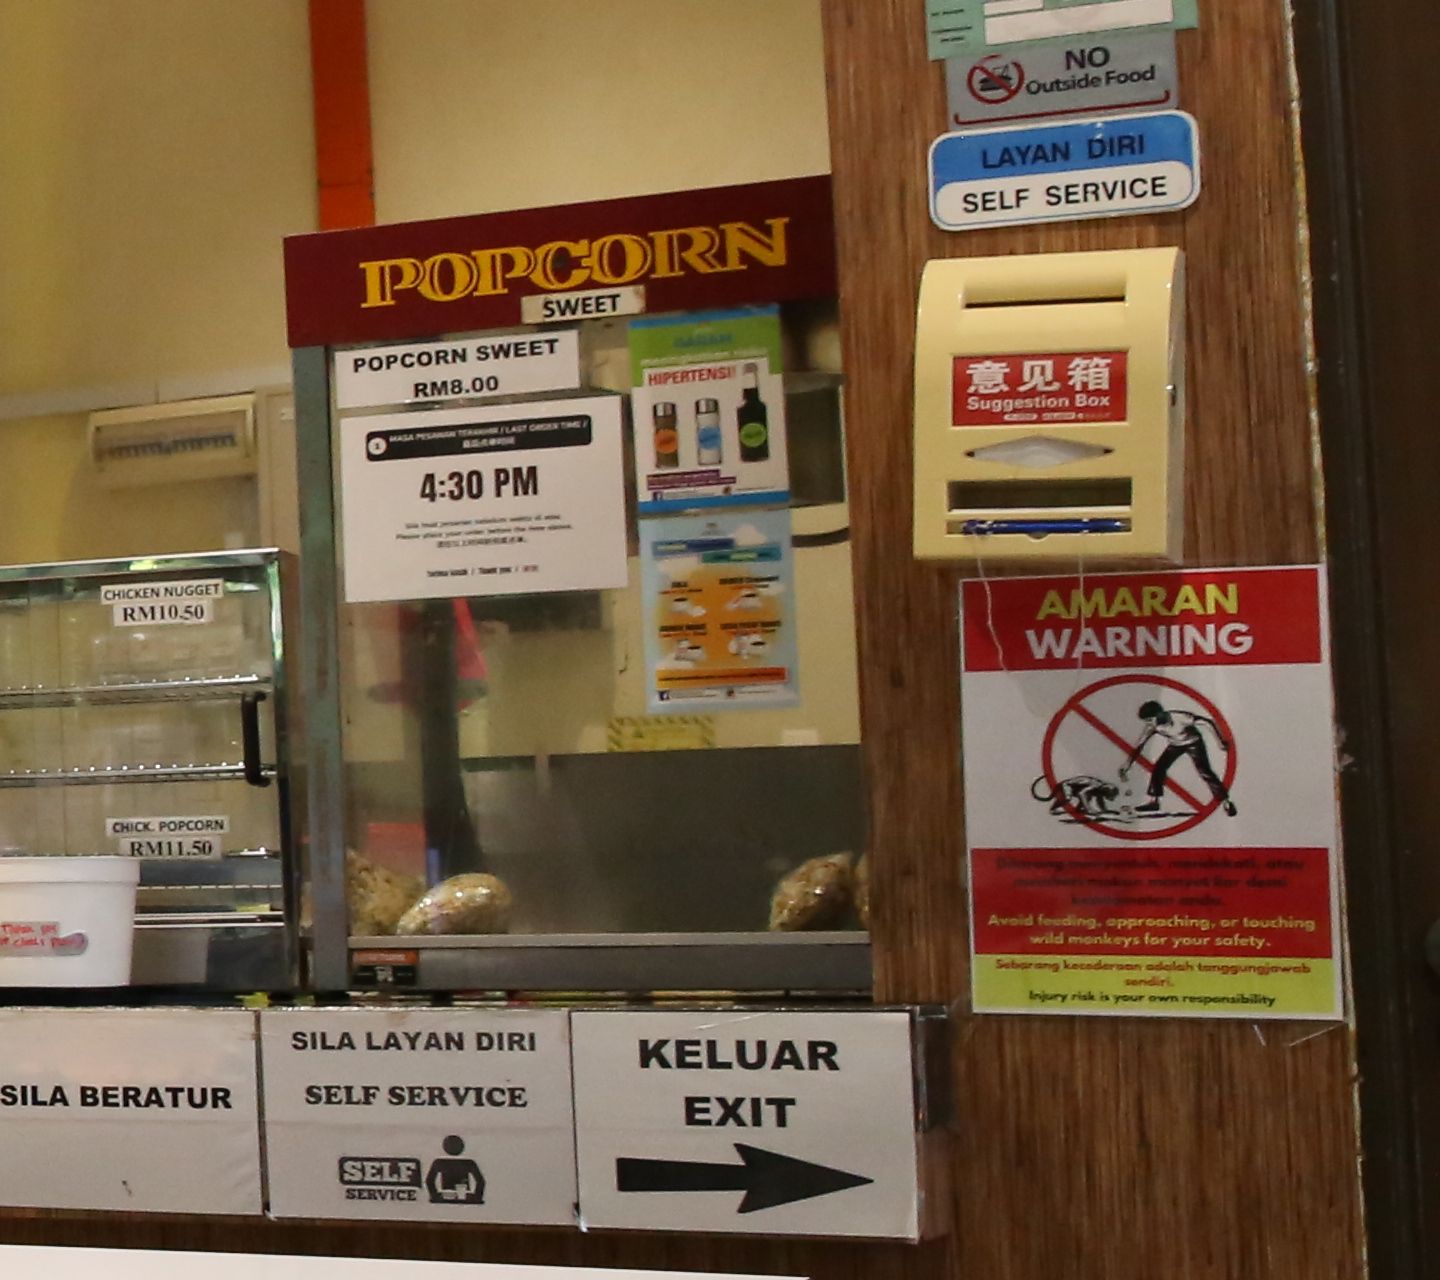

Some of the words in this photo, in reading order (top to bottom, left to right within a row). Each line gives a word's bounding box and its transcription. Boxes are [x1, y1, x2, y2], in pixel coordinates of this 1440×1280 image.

[1065, 47, 1110, 70] NO
[1026, 72, 1101, 95] Outside
[1105, 65, 1155, 85] Food
[982, 141, 1070, 169] LAYAN
[1088, 134, 1144, 158] DIRI
[963, 188, 1029, 212] SELF
[1046, 176, 1167, 205] SERVICE
[359, 217, 790, 308] POPCORN
[543, 294, 621, 318] SWEET
[353, 349, 467, 373] POPCORN
[476, 339, 559, 361] SWEET
[413, 376, 499, 398] RM8.00
[966, 357, 1112, 394] 意见箱
[967, 395, 1069, 412] Suggestion
[1075, 393, 1110, 406] Box
[420, 471, 482, 503] 4:30
[494, 466, 538, 498] PM
[103, 588, 159, 601] CHICKEN
[165, 583, 220, 597] NUGGET
[1037, 583, 1238, 619] AMARAN
[123, 604, 204, 622] RM10.50
[1025, 623, 1254, 659] WARNING
[112, 821, 154, 834] CHICK.
[159, 819, 224, 832] POPCORN
[130, 840, 212, 857] RM11.50
[988, 915, 1033, 927] Avoid
[1038, 915, 1102, 930] feeding,
[1106, 915, 1215, 931] approaching,
[1221, 917, 1239, 928] or
[1244, 916, 1315, 931] touching
[1030, 933, 1064, 945] wild
[1069, 933, 1140, 947] monkeys
[1145, 933, 1166, 945] for
[1172, 936, 1209, 949] your
[1215, 934, 1271, 949] safety.
[1029, 990, 1067, 1003] Injury
[1071, 991, 1095, 1002] risk
[1100, 991, 1108, 1002] is
[1113, 994, 1144, 1004] your
[1149, 994, 1179, 1003] own
[1183, 993, 1275, 1006] responsibility
[292, 1031, 356, 1051] SILA
[365, 1032, 464, 1051] LAYAN
[476, 1032, 536, 1052] DIRI
[639, 1039, 839, 1070] KELUAR
[0, 1085, 69, 1107] SILA
[79, 1086, 231, 1109] BERATUR
[305, 1085, 380, 1105] SELF
[388, 1086, 527, 1108] SERVICE
[685, 1096, 796, 1128] EXIT
[342, 1161, 418, 1183] SELF
[345, 1189, 416, 1201] SERVICE
